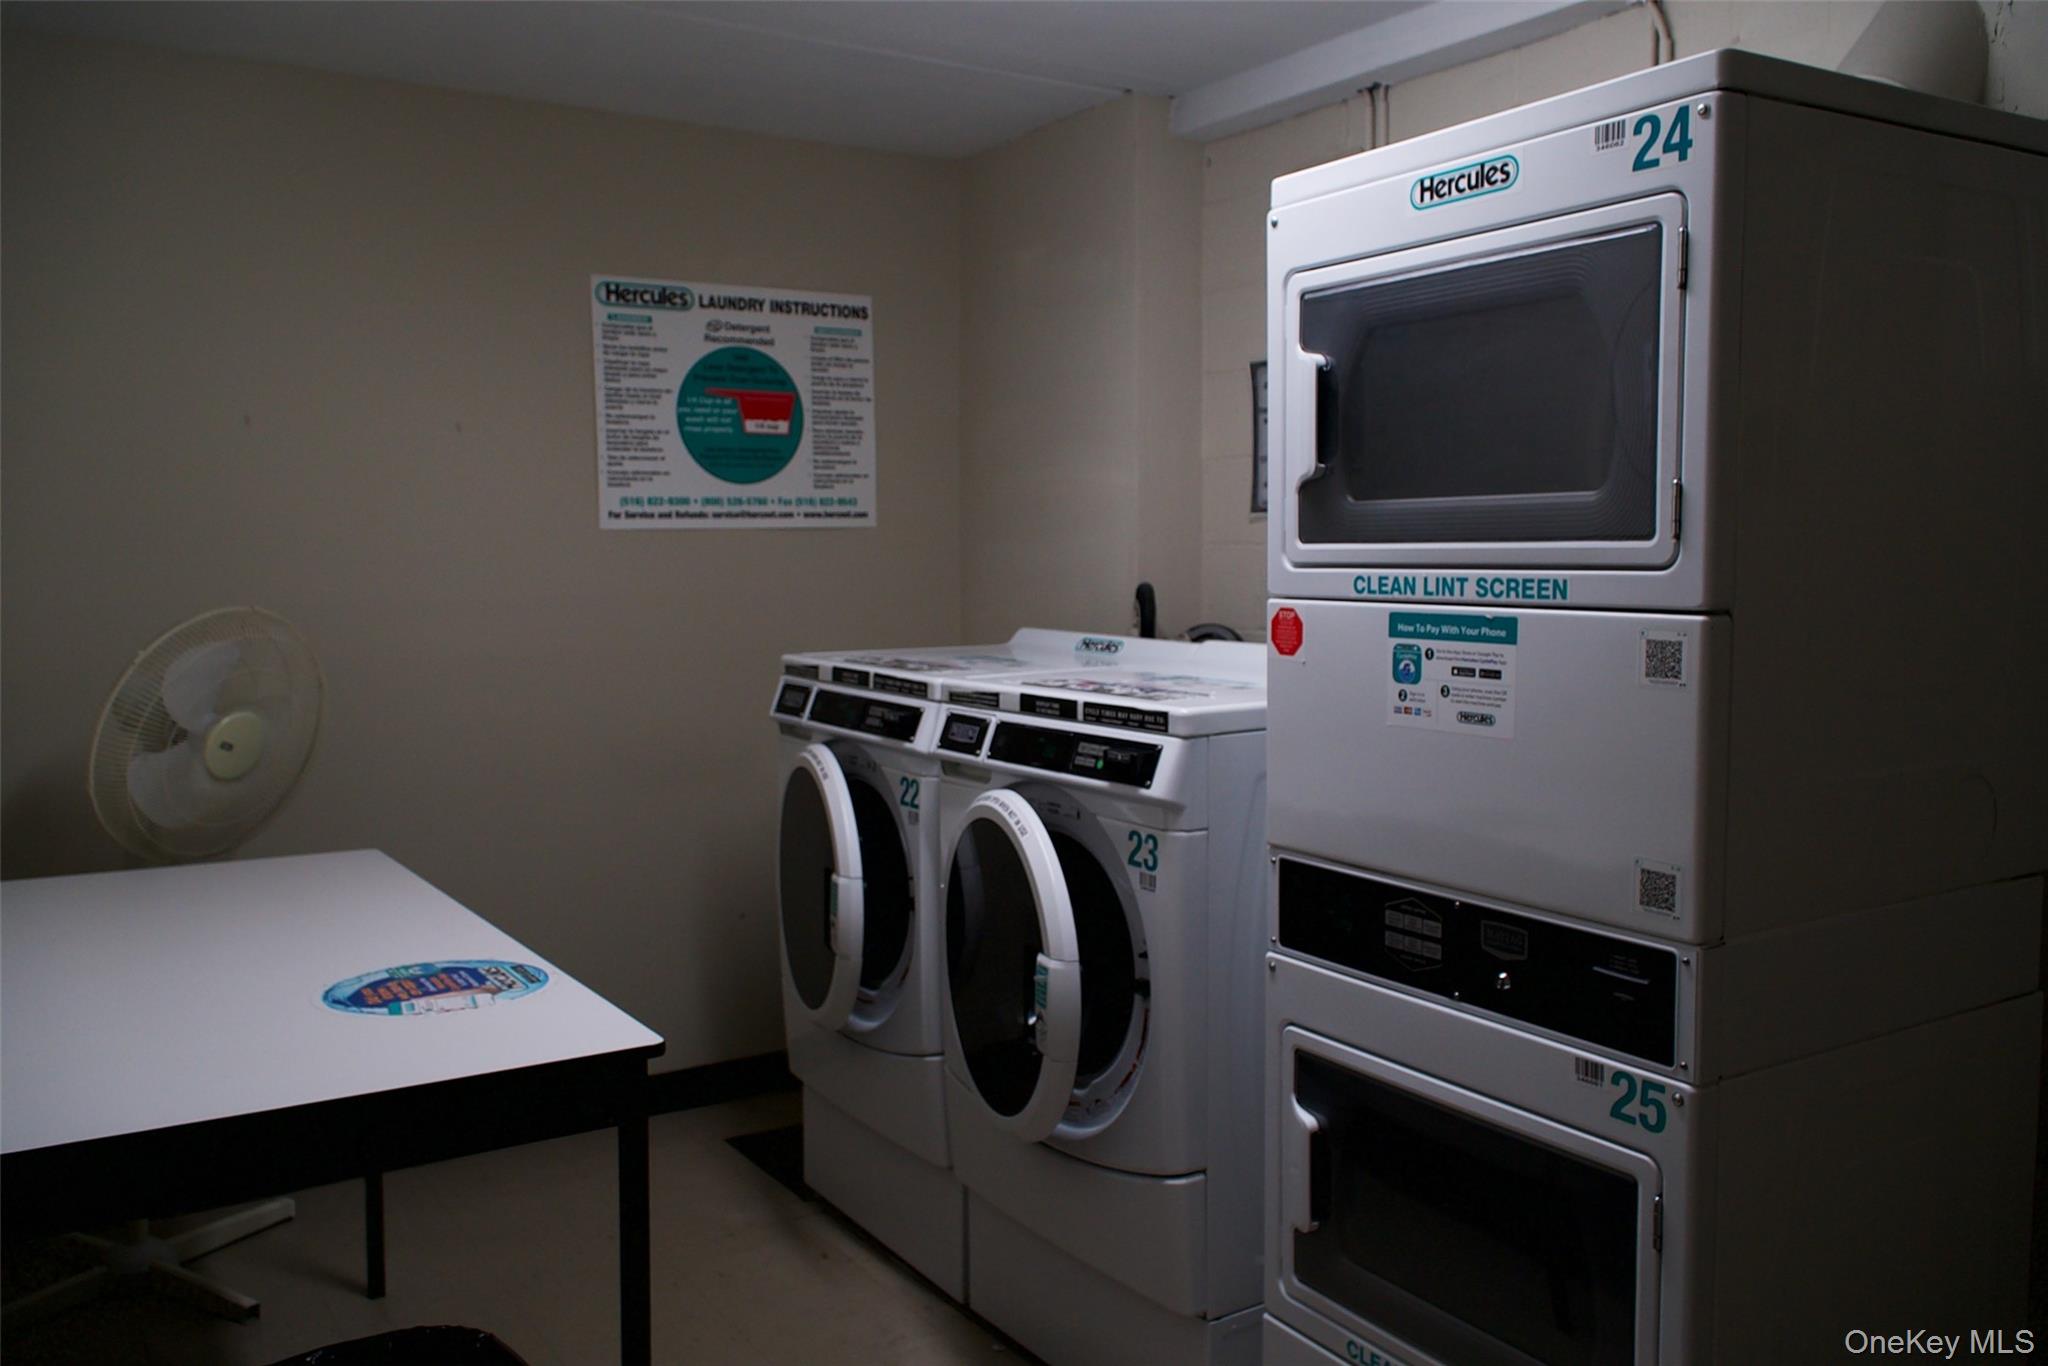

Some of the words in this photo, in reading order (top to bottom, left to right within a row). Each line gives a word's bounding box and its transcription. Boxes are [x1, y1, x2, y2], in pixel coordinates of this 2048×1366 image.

[1632, 105, 1693, 172] 24
[1419, 161, 1510, 203] Hercules
[605, 282, 689, 307] Hercules
[698, 294, 766, 313] LAUNDRY
[769, 299, 869, 320] INSTRUCTIONS
[704, 333, 775, 347] Recommended
[725, 321, 770, 334] Detergent
[608, 509, 622, 519] For
[624, 510, 656, 519] Service
[657, 510, 673, 519] and
[778, 497, 793, 506] Fax
[1354, 576, 1416, 595] CLEAN
[1423, 577, 1468, 597] LINT
[1476, 578, 1568, 600] SCREEN
[1397, 623, 1414, 633] How
[1416, 624, 1425, 633] To
[1426, 625, 1440, 636] Pay
[1441, 625, 1460, 635] With
[1461, 626, 1480, 636] Your
[1481, 628, 1507, 638] Phone
[900, 776, 919, 808] 22
[1128, 830, 1158, 871] 23
[1610, 1071, 1666, 1133] 25
